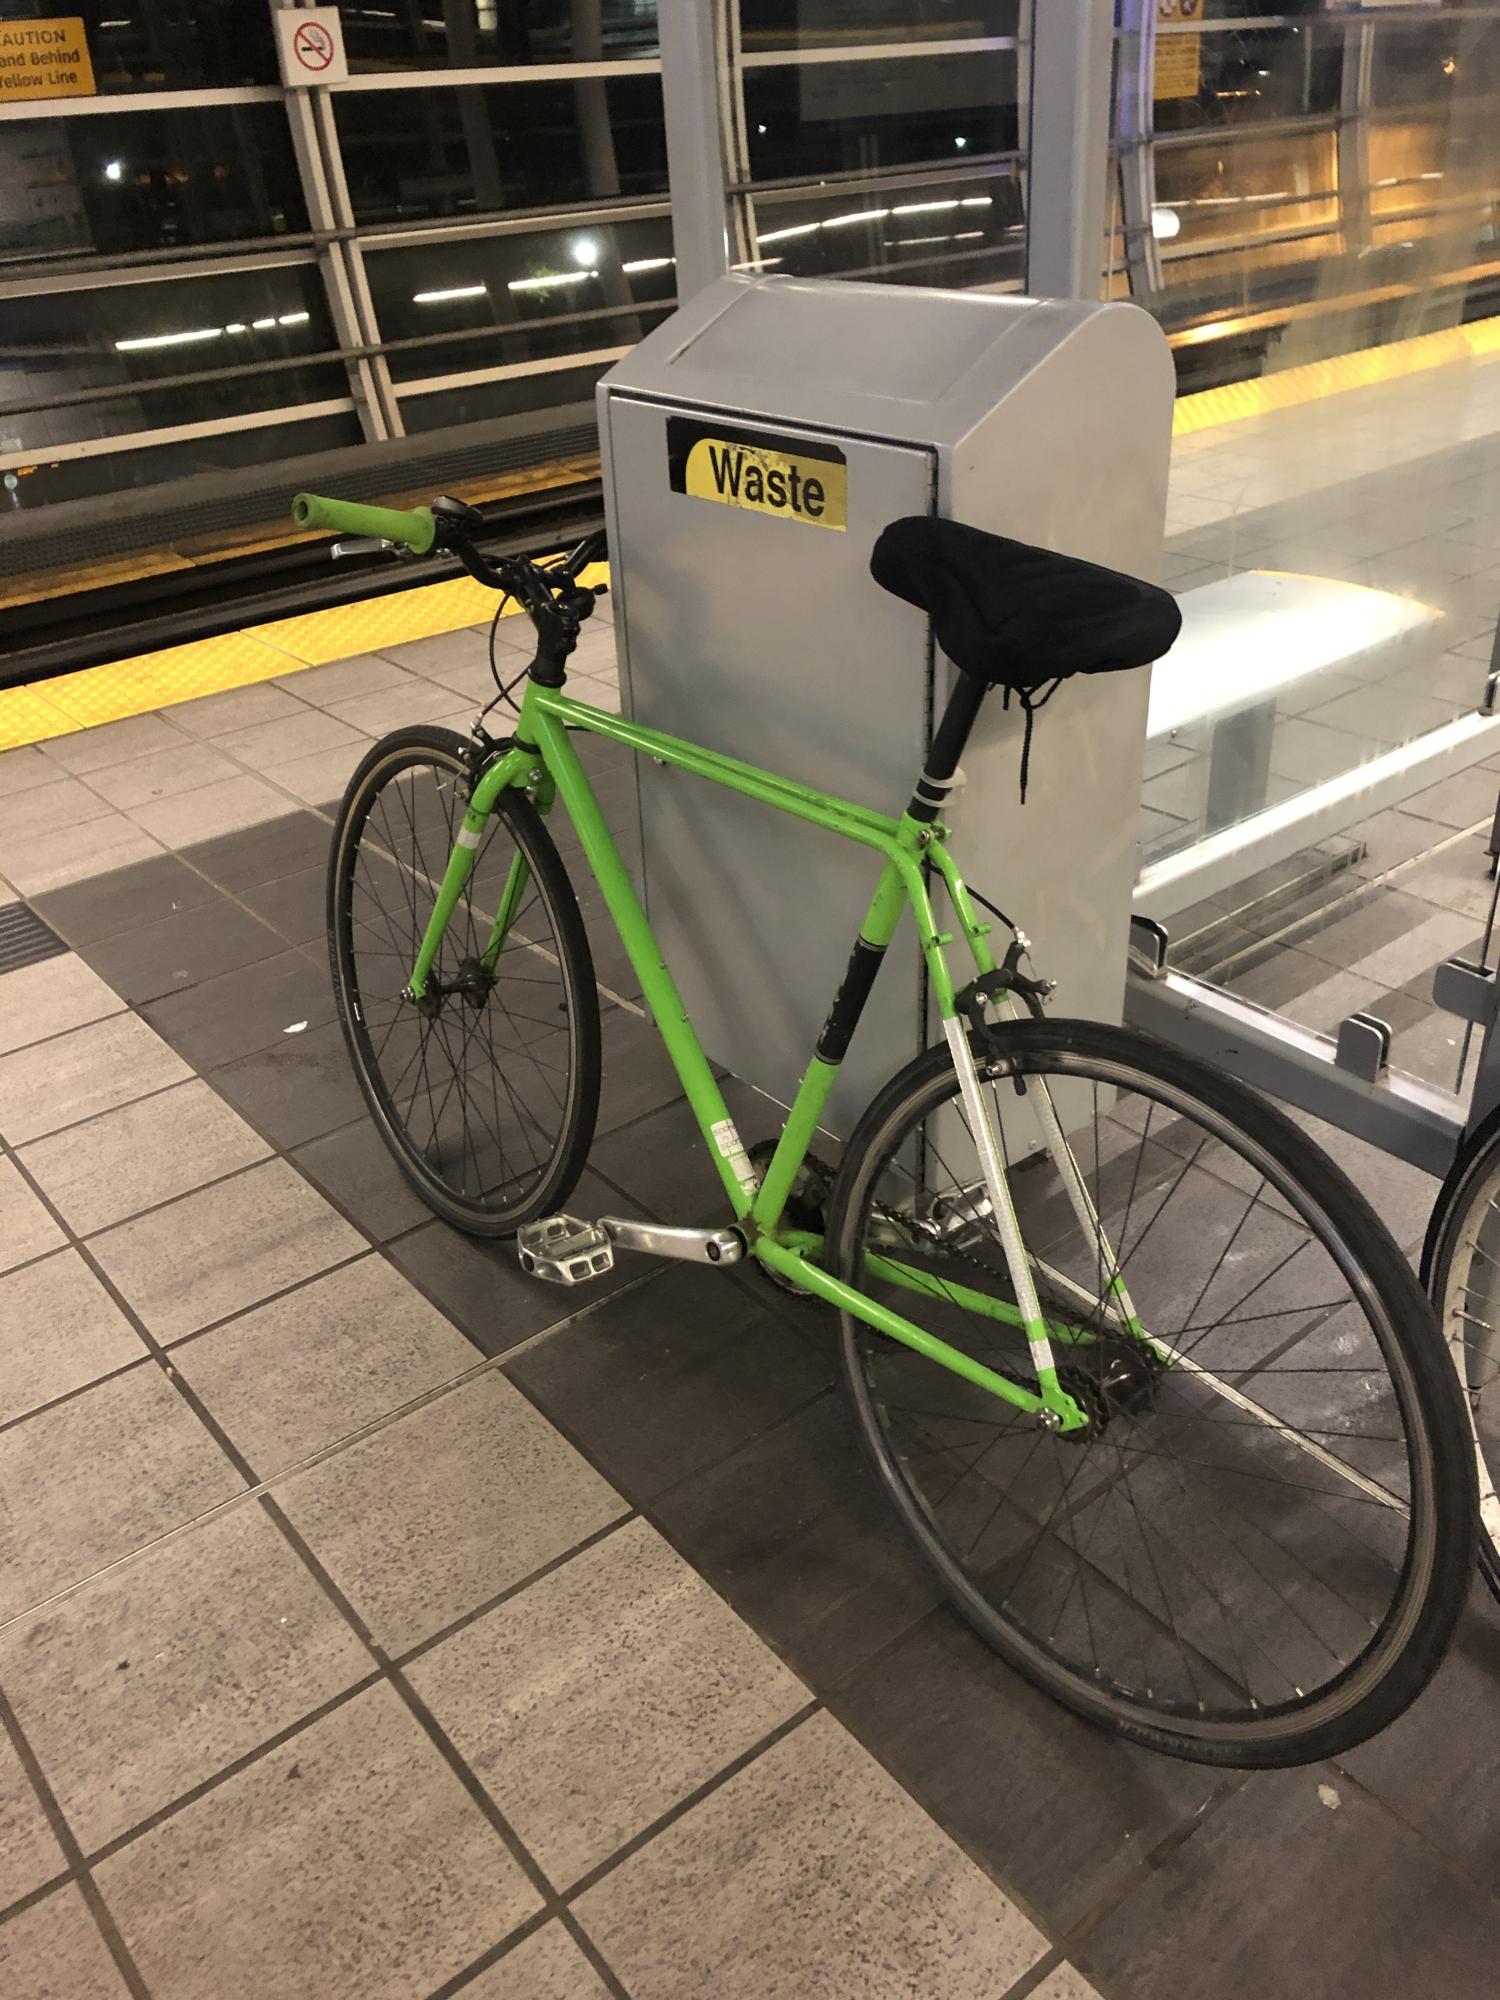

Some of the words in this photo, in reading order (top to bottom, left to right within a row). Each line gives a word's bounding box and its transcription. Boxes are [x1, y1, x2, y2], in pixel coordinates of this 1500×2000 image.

[0, 29, 66, 46] AUTION
[0, 52, 26, 68] and
[30, 48, 80, 65] Behind
[48, 71, 78, 85] Line
[708, 445, 825, 517] Waste
